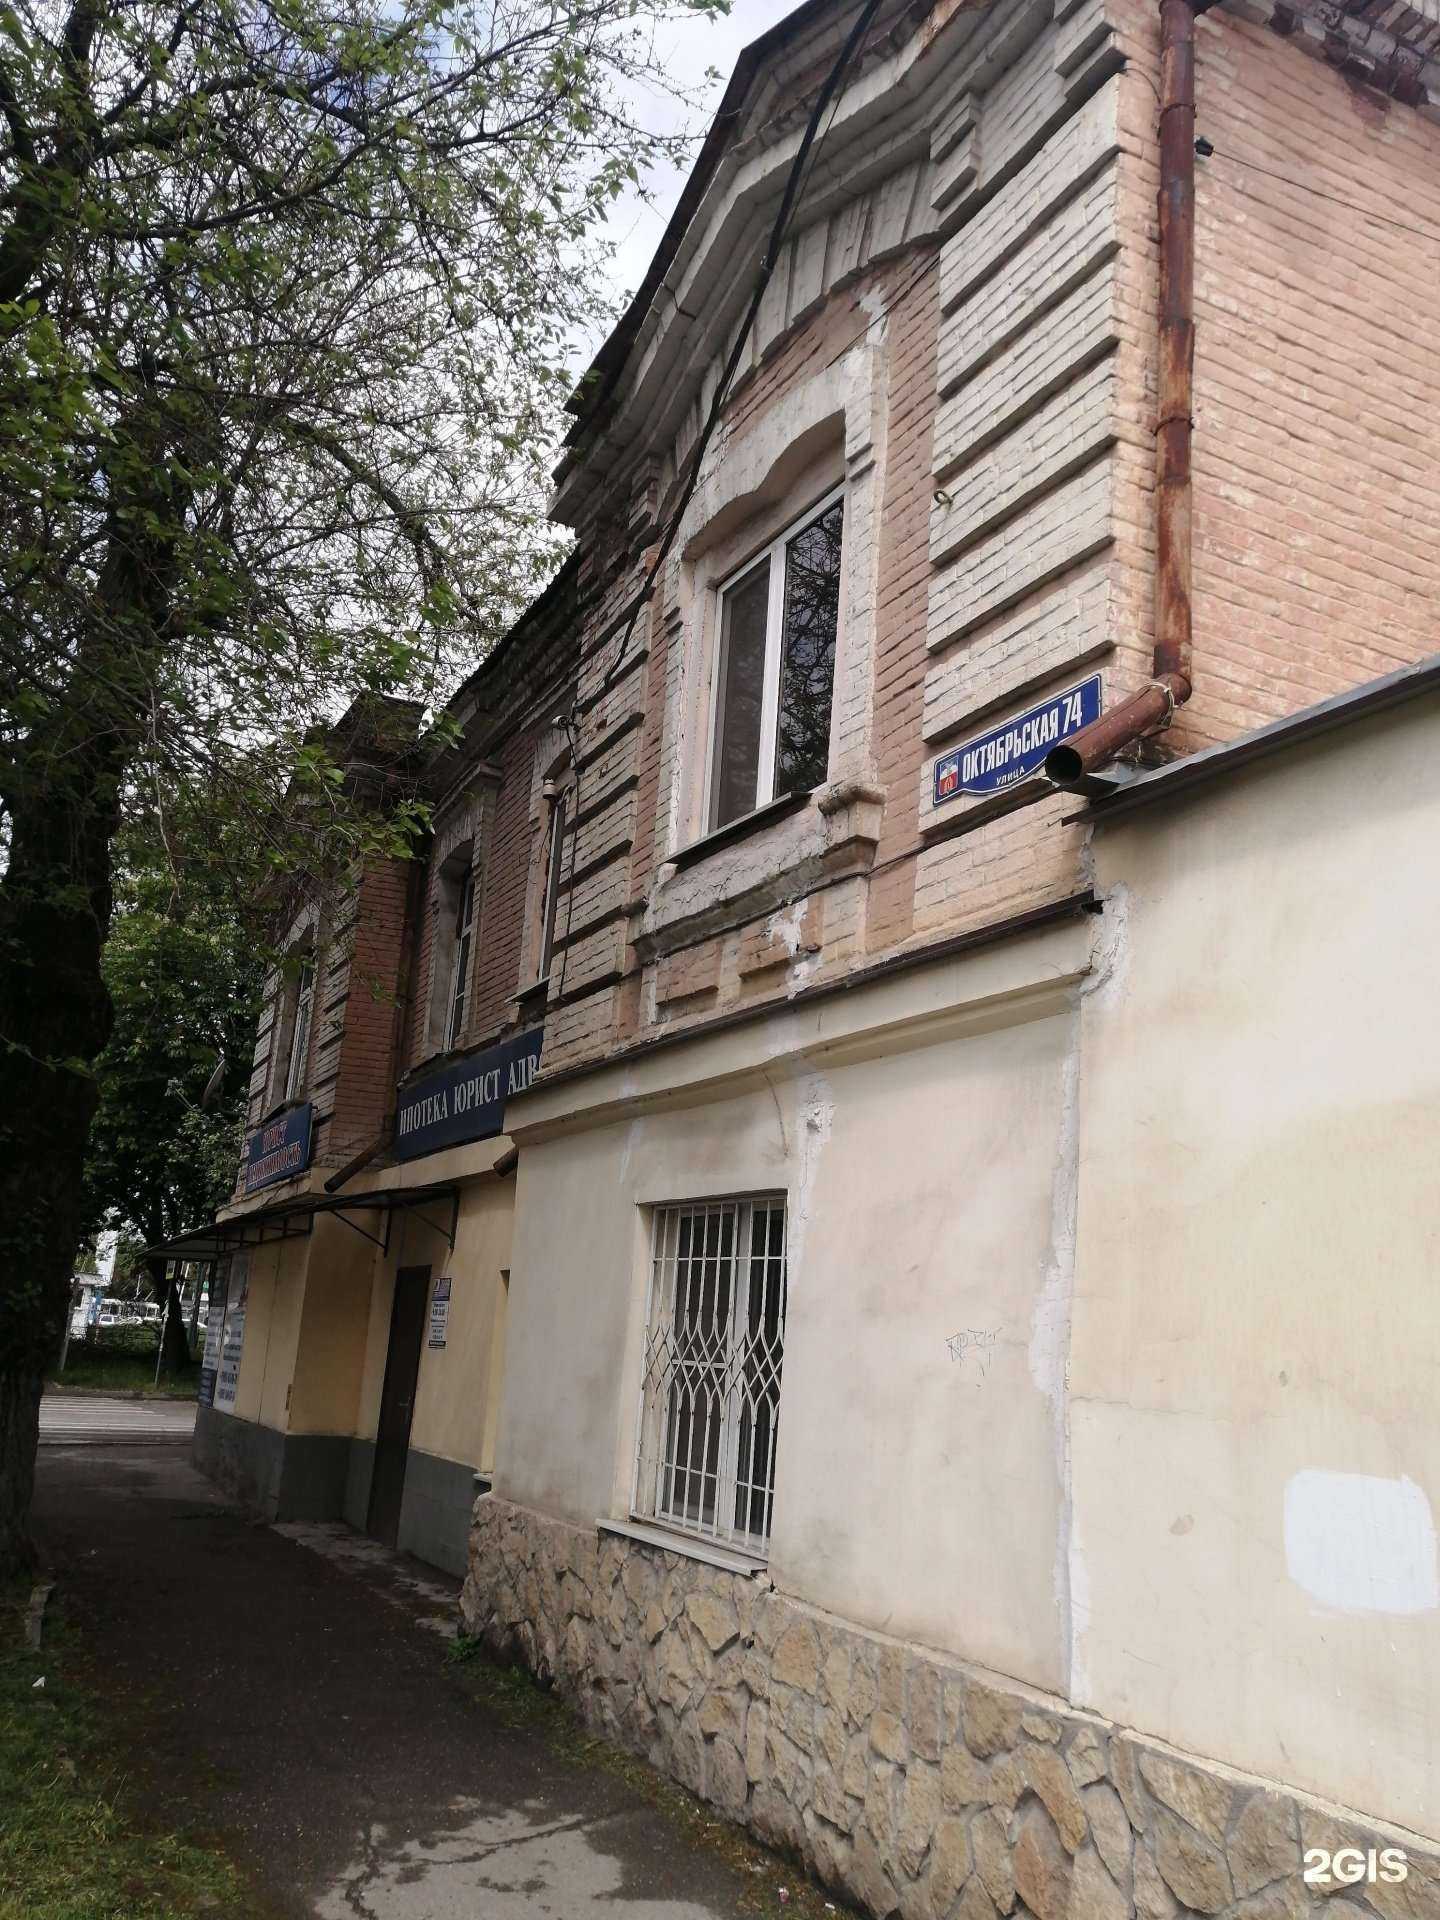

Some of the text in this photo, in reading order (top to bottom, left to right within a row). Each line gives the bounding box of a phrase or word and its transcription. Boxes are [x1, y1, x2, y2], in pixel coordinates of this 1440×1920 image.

[962, 691, 1083, 783] ОКТЯБРЬСКАЯ 74
[996, 766, 1025, 786] УЛИЦА
[399, 1091, 449, 1136] ИПОТЕКА
[453, 1069, 501, 1115] ЮРИСТ
